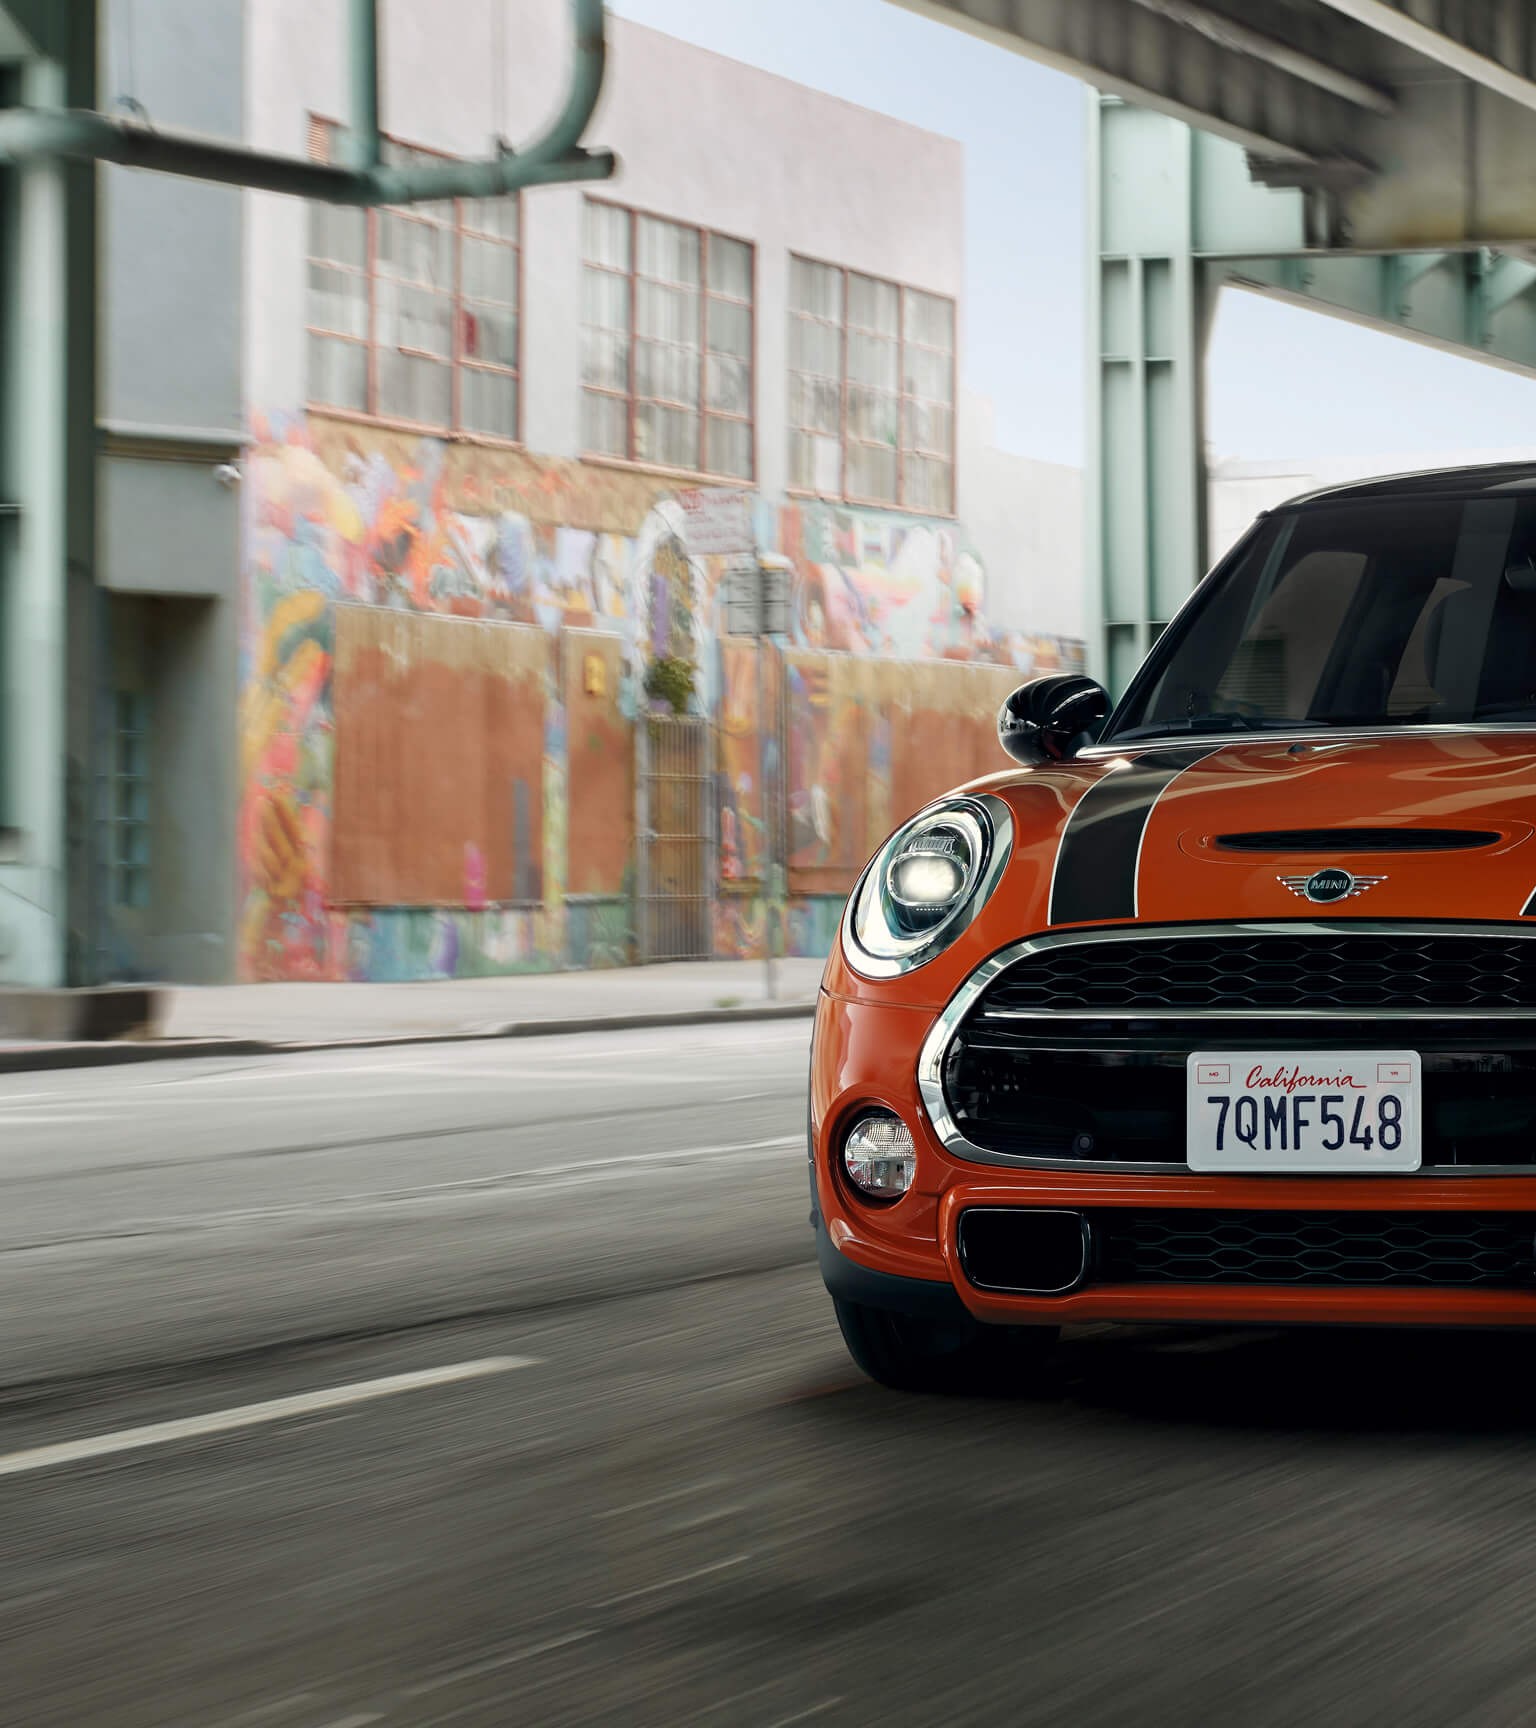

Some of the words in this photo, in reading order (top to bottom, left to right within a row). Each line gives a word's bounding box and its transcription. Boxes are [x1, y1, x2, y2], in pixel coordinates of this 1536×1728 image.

[1310, 879, 1348, 889] MINI
[1245, 1064, 1367, 1094] California
[1207, 1094, 1401, 1151] 7QMF548
